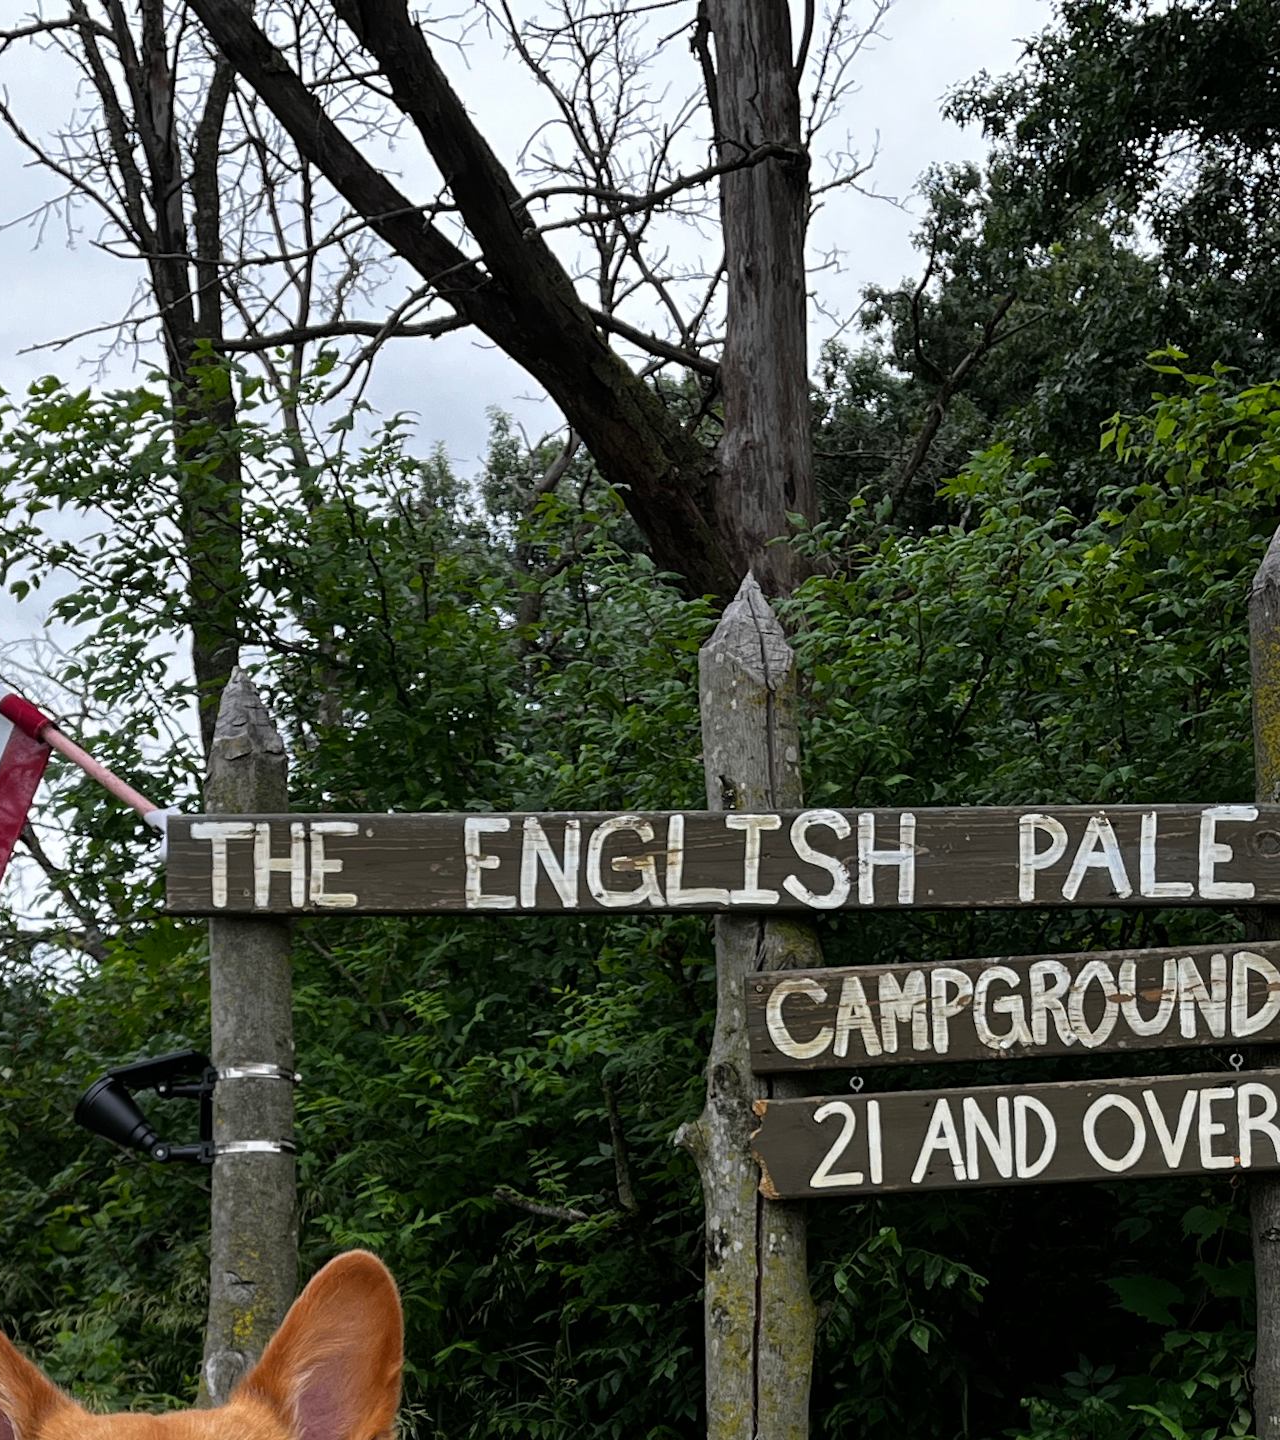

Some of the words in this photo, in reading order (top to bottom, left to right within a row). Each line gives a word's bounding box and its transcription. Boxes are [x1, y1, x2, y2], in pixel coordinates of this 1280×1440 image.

[189, 821, 359, 909] THE
[464, 807, 917, 910] ENGLISH
[1018, 806, 1259, 903] PALE
[809, 1100, 884, 1189] 21
[910, 1095, 1057, 1184] AND
